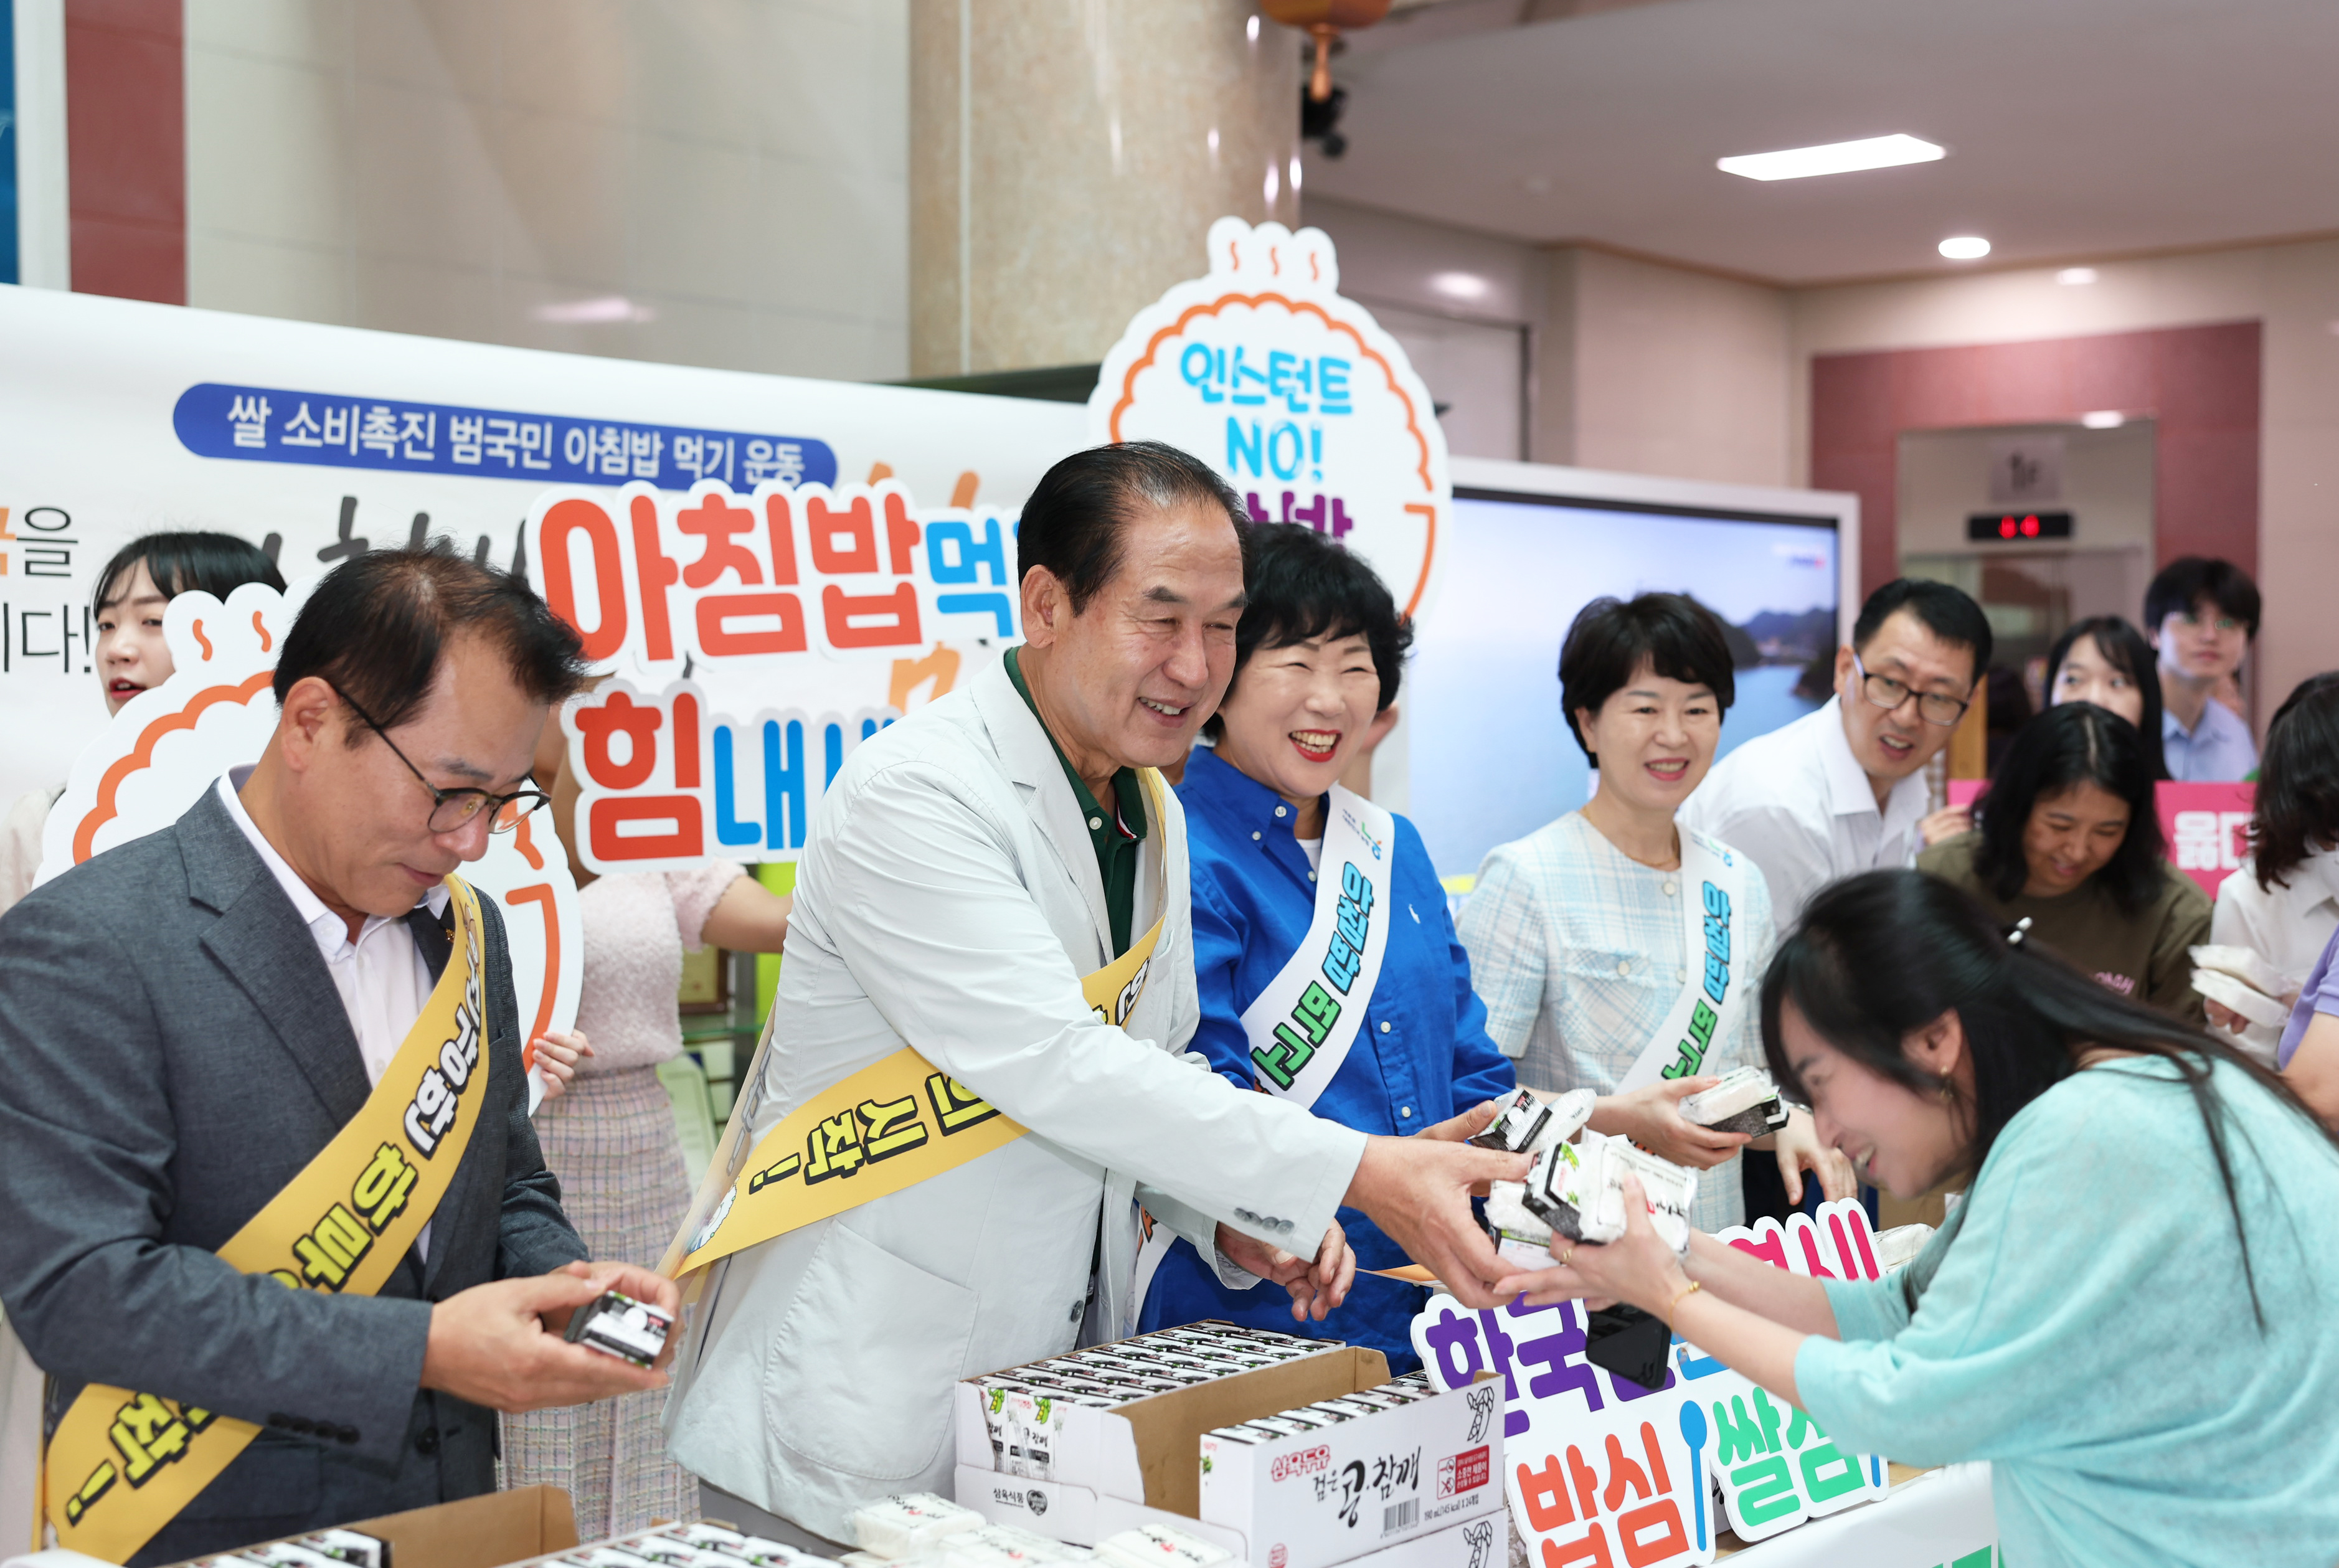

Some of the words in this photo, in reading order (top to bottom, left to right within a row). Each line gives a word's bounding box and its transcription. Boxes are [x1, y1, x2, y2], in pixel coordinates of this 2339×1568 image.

[1181, 342, 1352, 413] 인스턴트
[227, 395, 272, 448] 쌀
[281, 402, 436, 461] 소비촉진
[450, 414, 553, 470] 범국민
[564, 425, 664, 478] 아침밥
[673, 434, 735, 483] 먹기
[742, 439, 805, 488] 운동
[1226, 415, 1323, 483] NO!
[0, 507, 78, 577] 을
[925, 517, 1019, 638] 먹
[1323, 862, 1374, 995] 아침밥
[1701, 879, 1732, 1005] 아침밥
[404, 944, 482, 1158] 건강한
[1250, 980, 1343, 1090] 먹고
[749, 1094, 929, 1195] 시작!
[66, 1391, 218, 1528] 작!
[993, 1488, 1024, 1503] 삼육식품
[1271, 1445, 1331, 1482] 삼육두유
[1517, 1422, 1689, 1568] 밥심
